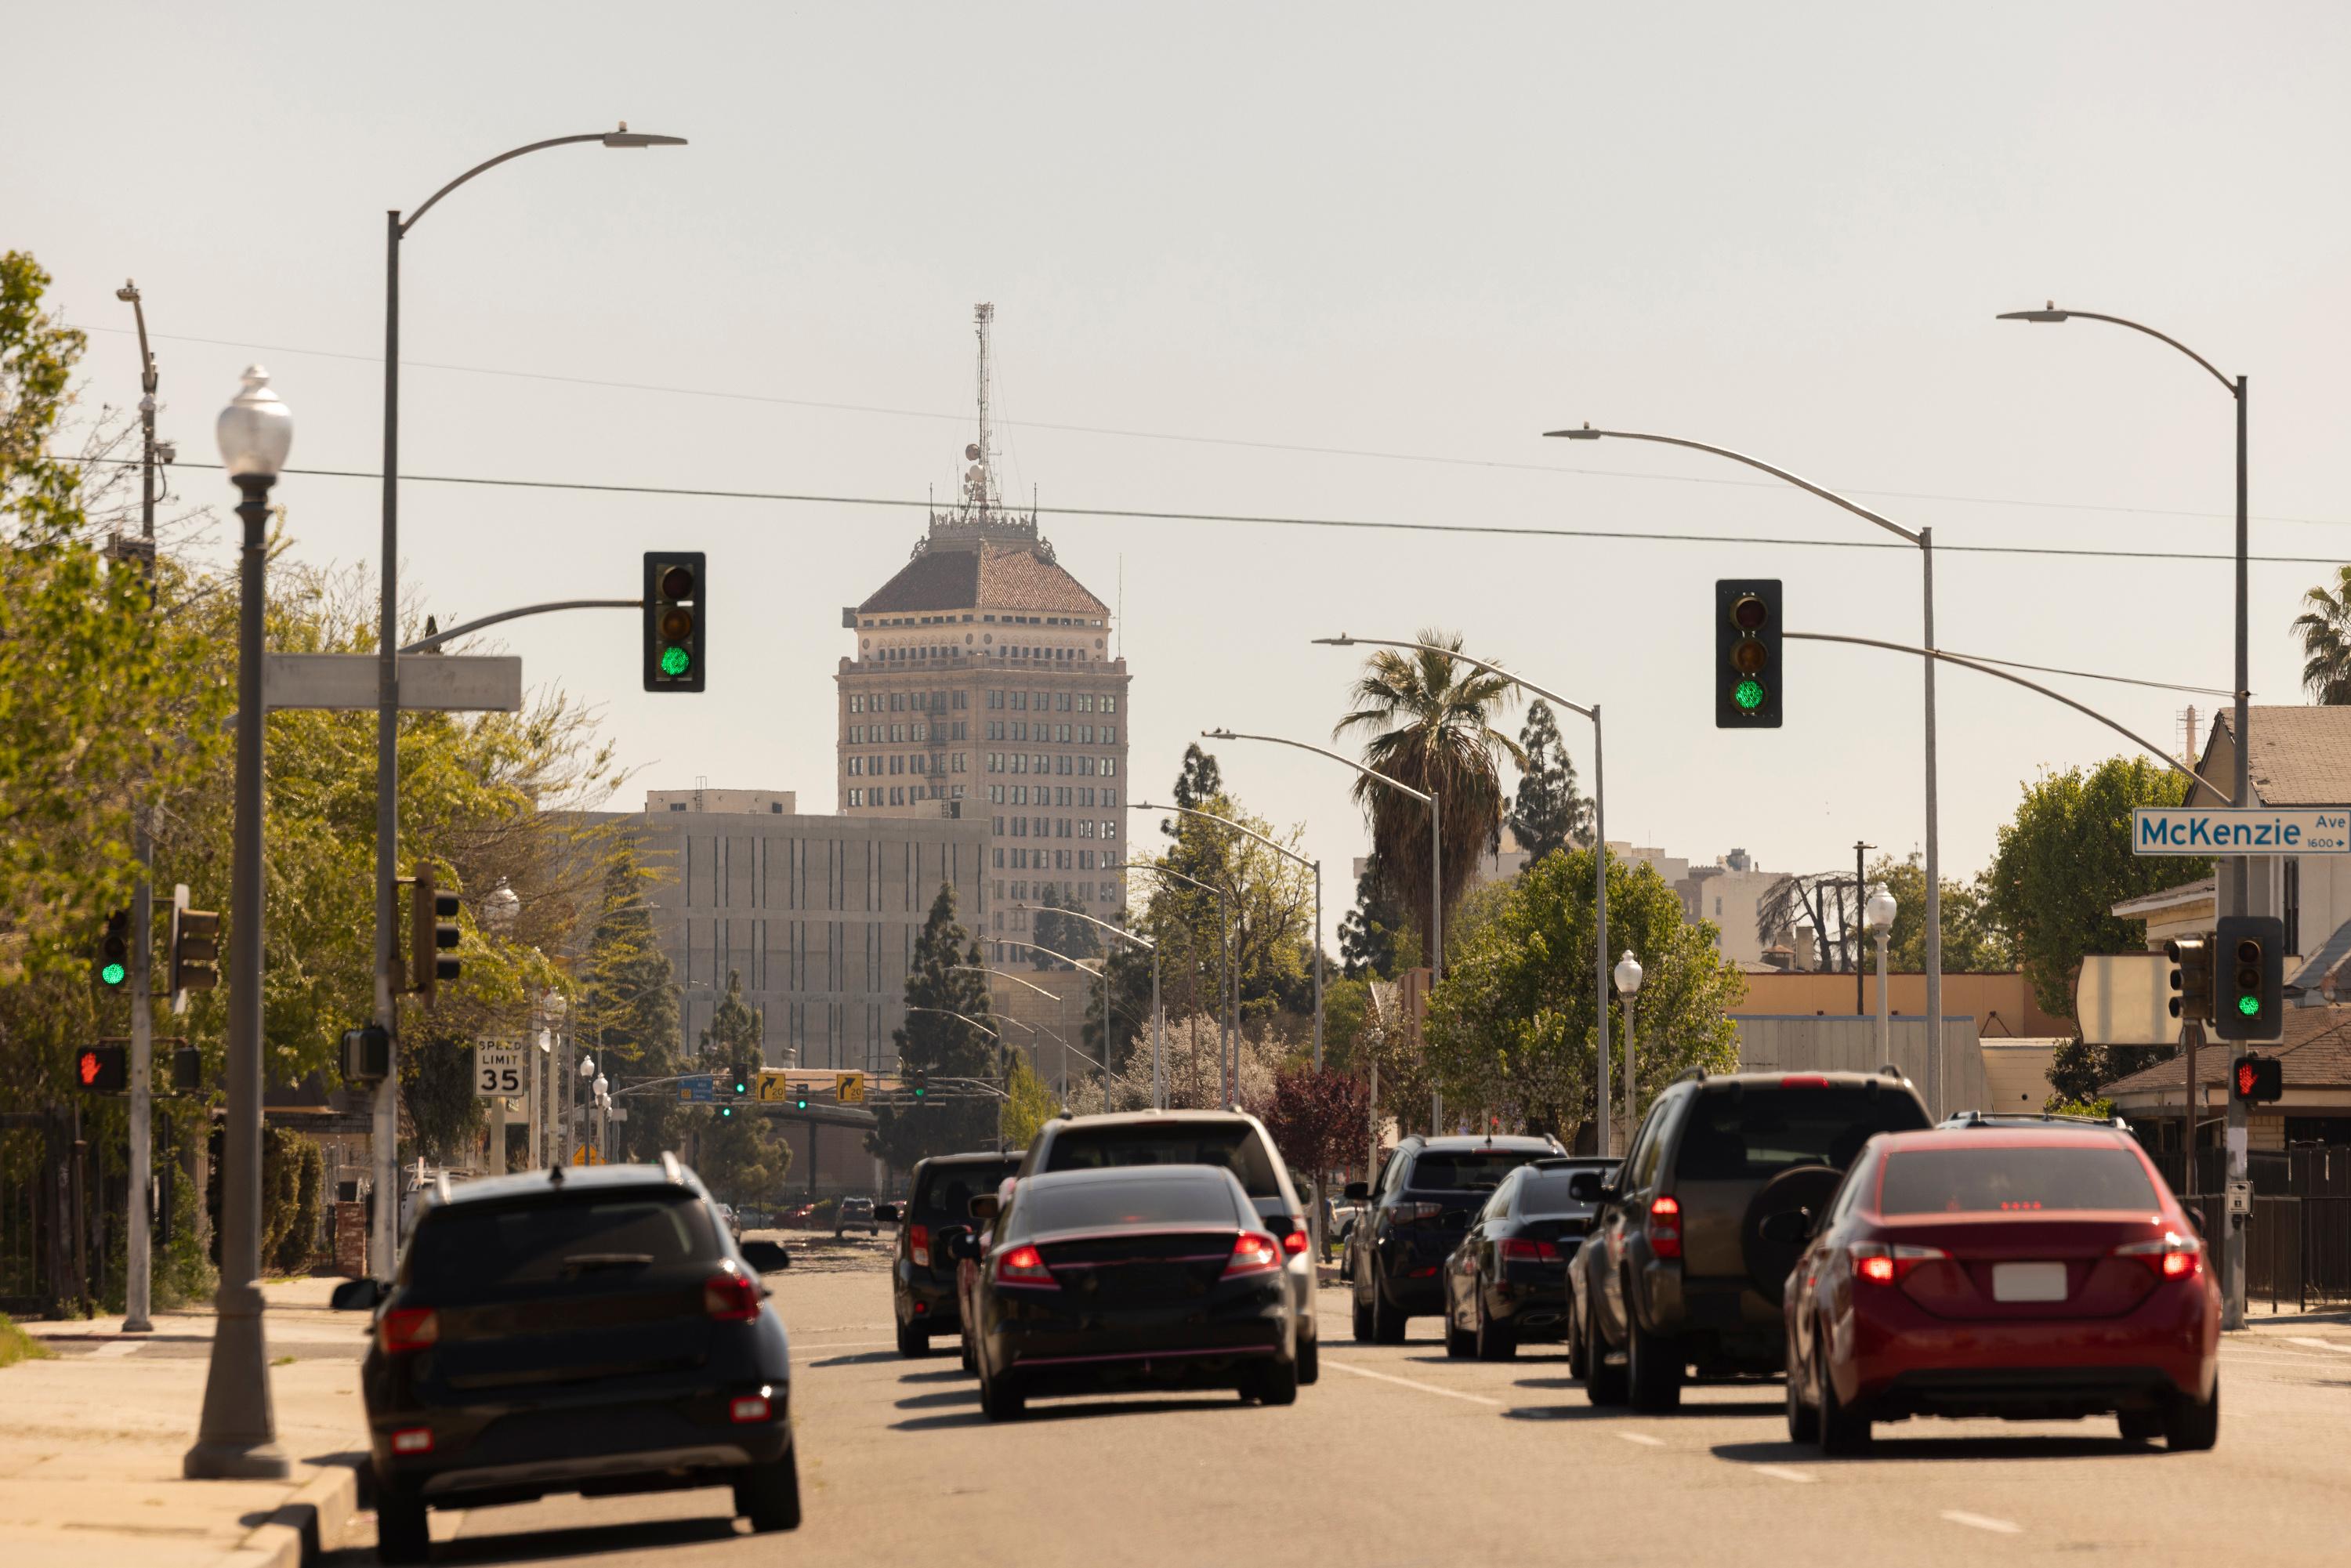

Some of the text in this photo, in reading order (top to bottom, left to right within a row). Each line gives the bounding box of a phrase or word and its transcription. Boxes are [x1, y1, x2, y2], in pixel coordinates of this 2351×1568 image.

[2142, 815, 2346, 846] McKenzie Ave
[2307, 838, 2334, 847] 1600
[483, 1055, 518, 1064] LIMIT
[480, 1069, 519, 1090] 35
